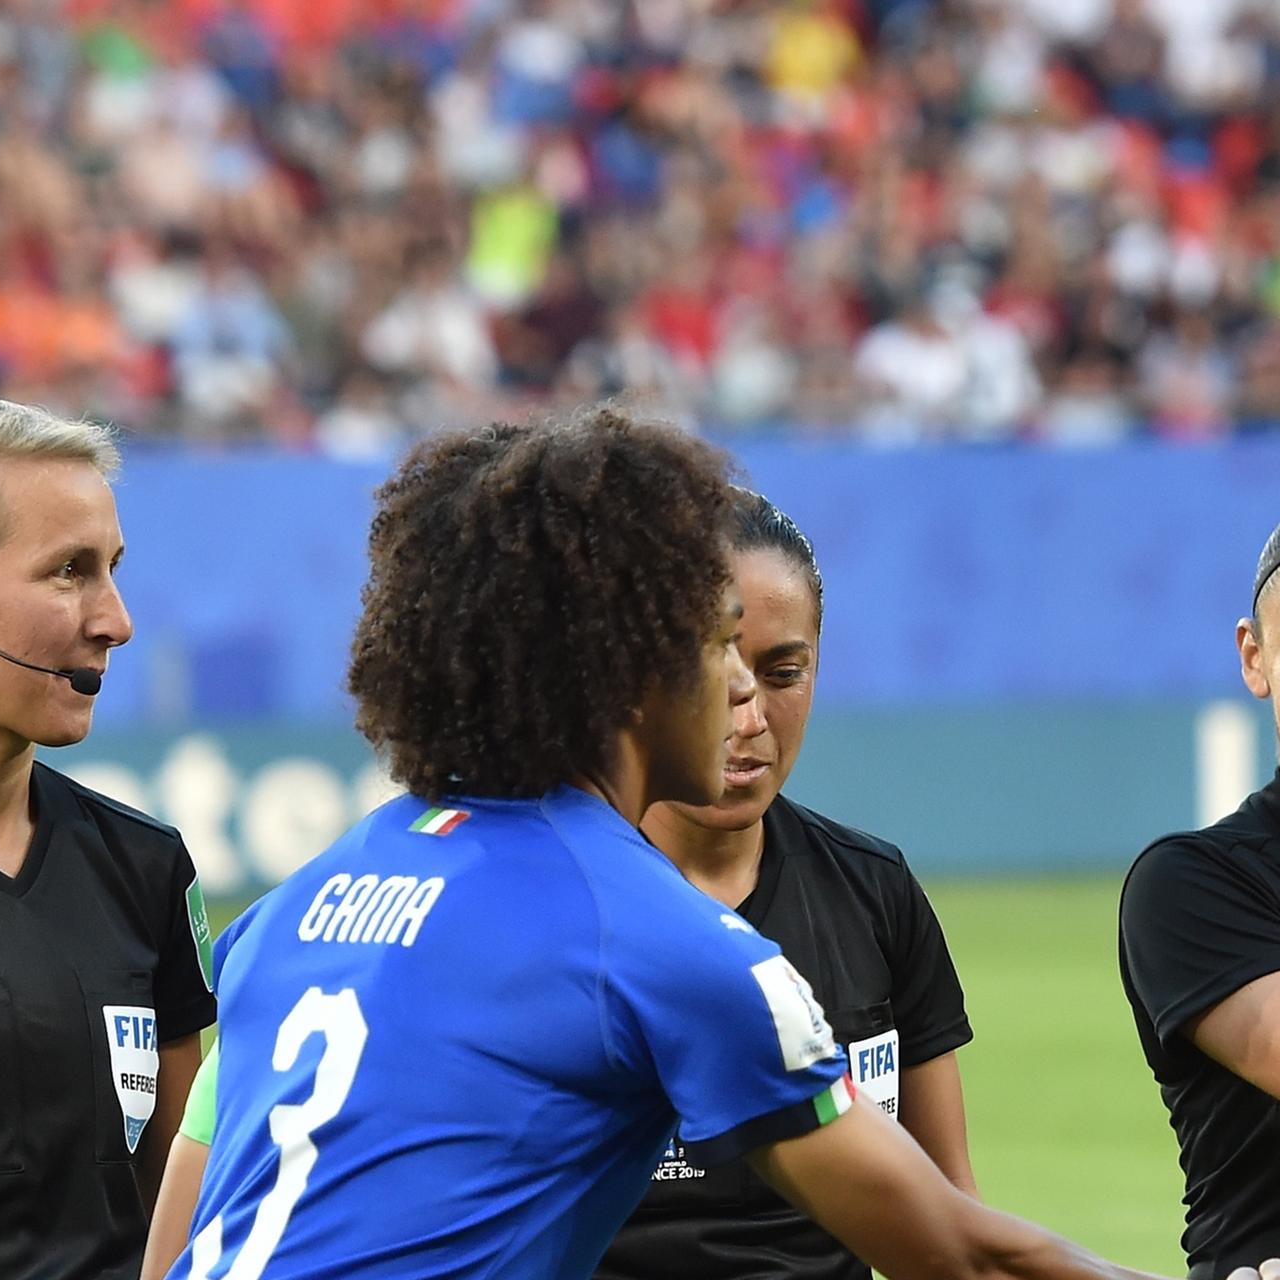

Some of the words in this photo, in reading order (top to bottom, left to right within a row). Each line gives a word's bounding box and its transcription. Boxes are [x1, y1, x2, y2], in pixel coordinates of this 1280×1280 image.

[297, 872, 444, 947] GAMA
[859, 1043, 894, 1083] FIFA
[651, 1168, 677, 1180] NCE
